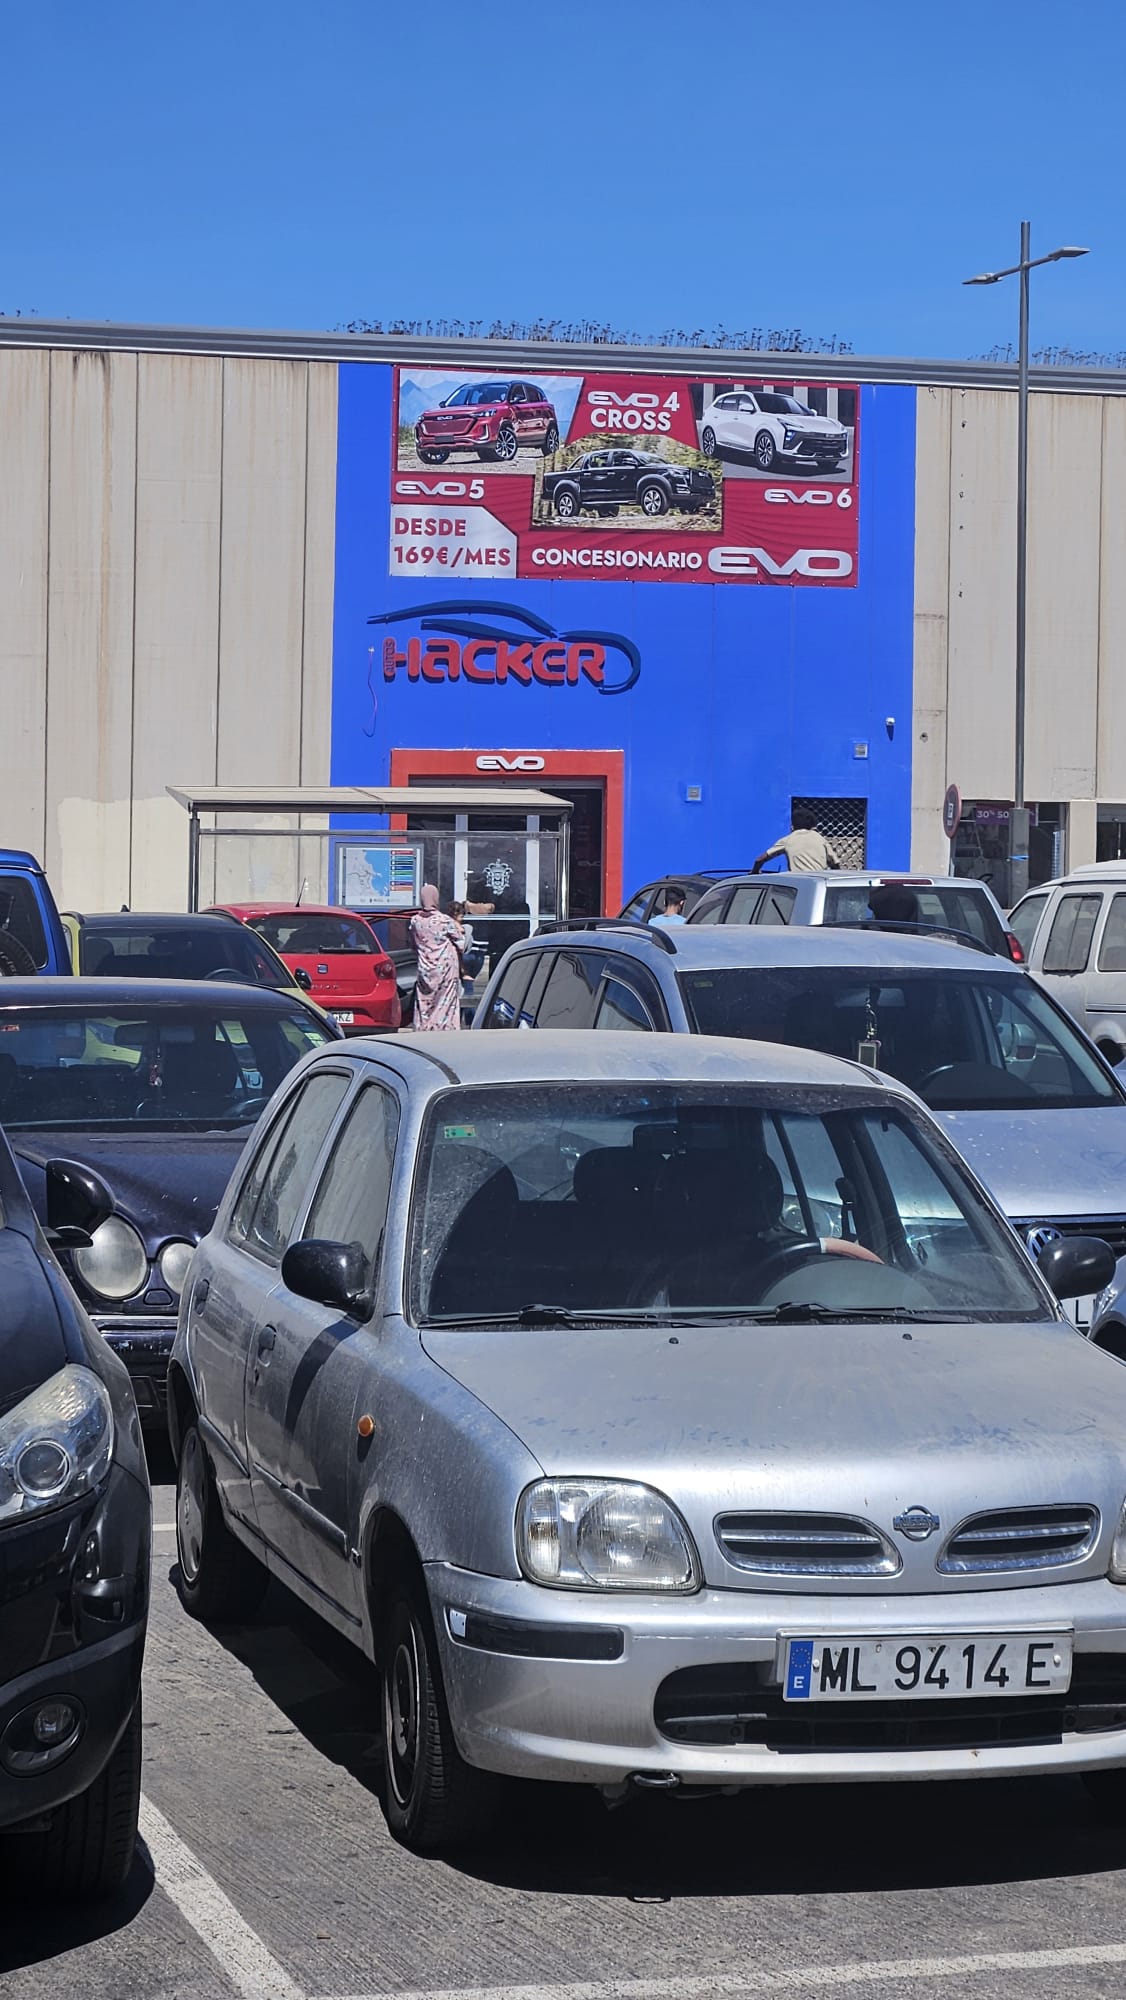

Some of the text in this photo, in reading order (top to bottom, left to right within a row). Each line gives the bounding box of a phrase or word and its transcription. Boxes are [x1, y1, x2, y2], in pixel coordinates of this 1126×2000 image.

[587, 391, 680, 412] EVO 4
[590, 408, 671, 432] CROSS
[395, 479, 485, 499] EVO 5
[764, 488, 853, 508] EVO 6
[394, 517, 466, 537] DESDE
[394, 546, 511, 568] 169€/MES
[531, 546, 853, 577] CONCESIONARIO EVO
[476, 755, 545, 770] EVO
[819, 1642, 1054, 1692] ML 9414 E
[793, 1675, 804, 1688] E
